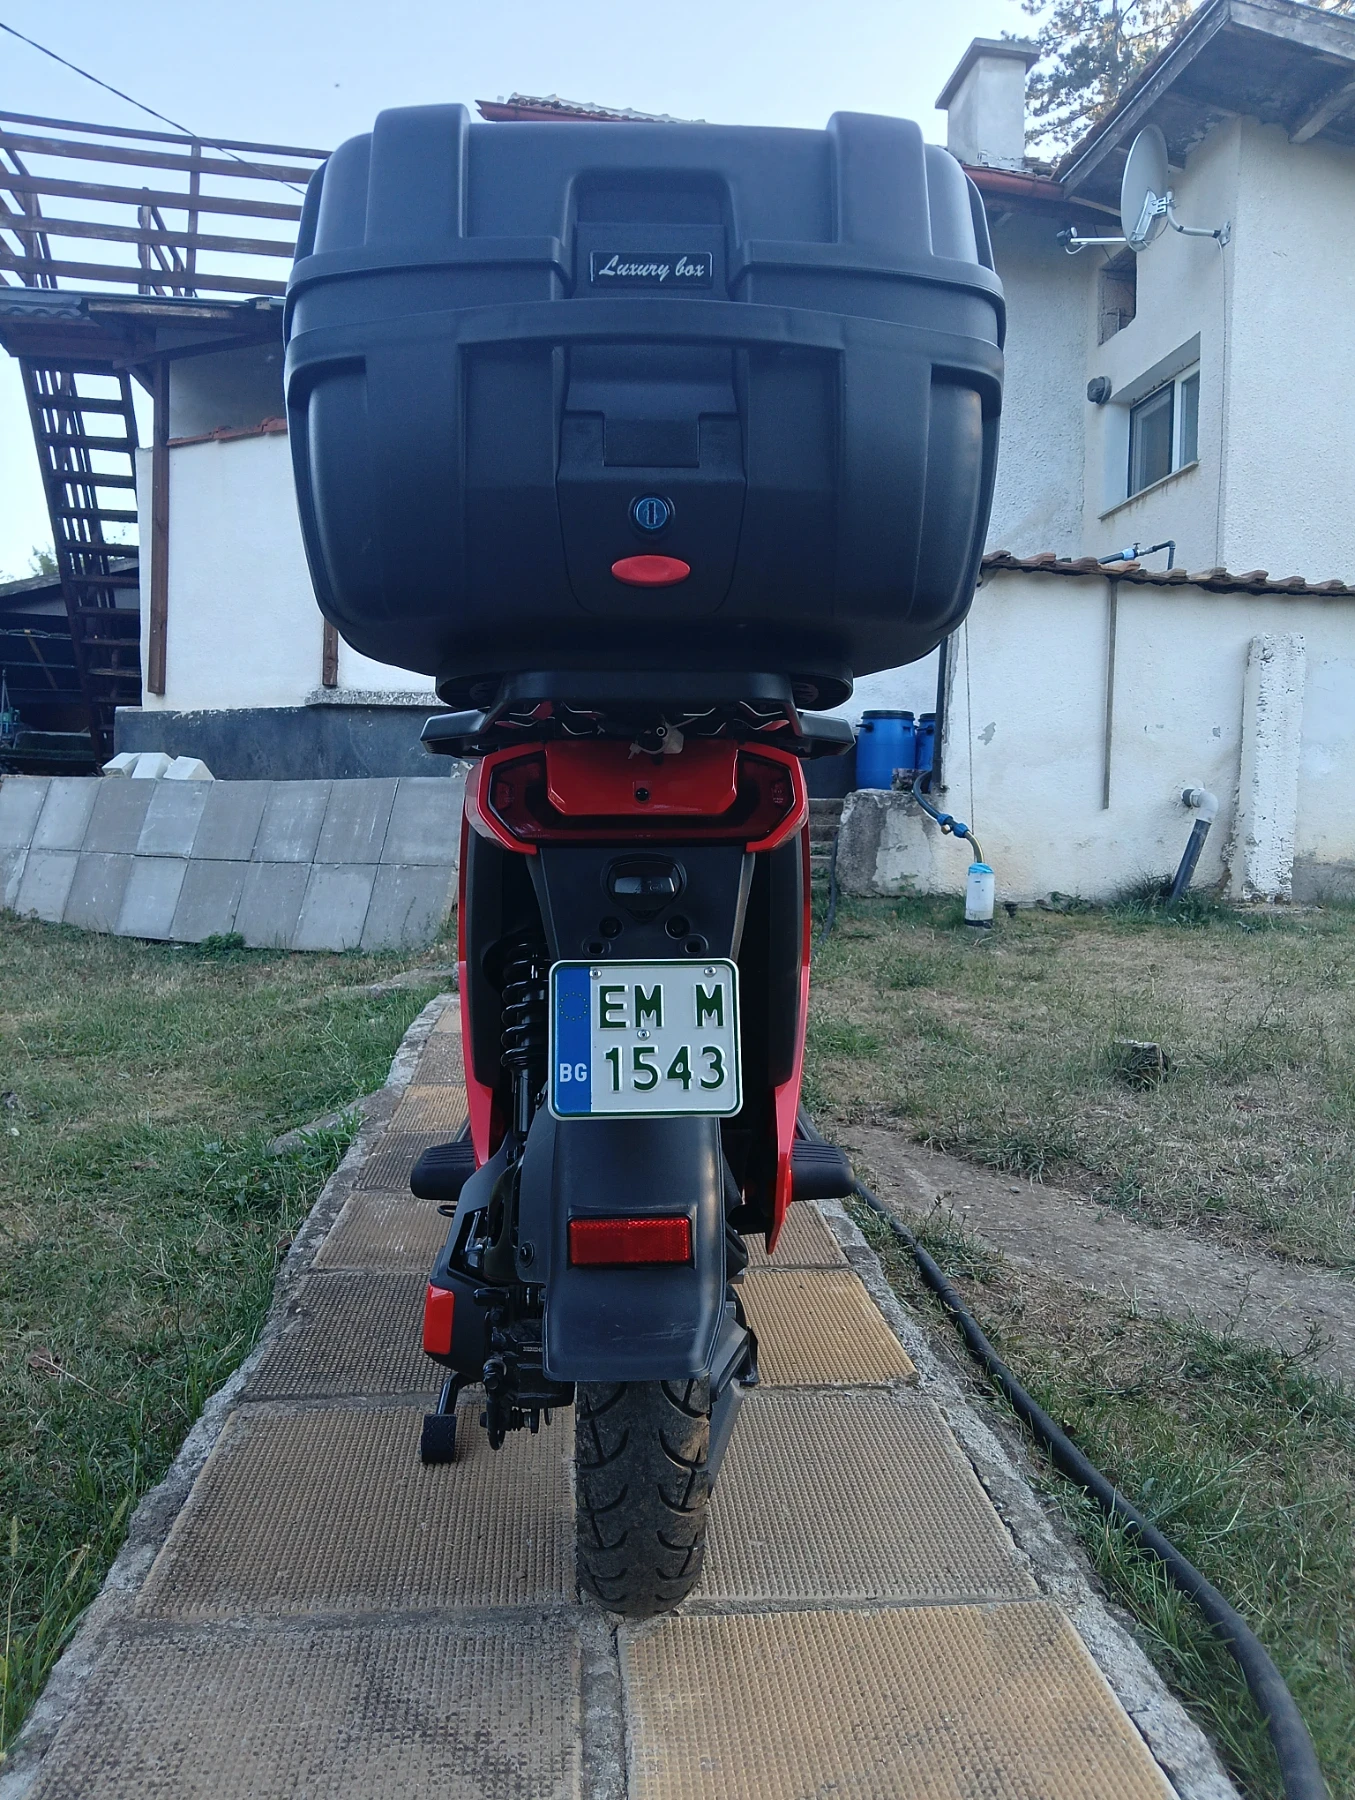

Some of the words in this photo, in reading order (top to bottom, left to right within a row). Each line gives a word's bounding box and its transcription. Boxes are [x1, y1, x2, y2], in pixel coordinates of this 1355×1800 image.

[598, 254, 670, 282] Luxury
[675, 256, 705, 276] box
[598, 984, 664, 1029] EM
[695, 983, 725, 1028] M
[559, 1063, 588, 1083] BG
[604, 1045, 727, 1092] 1543
